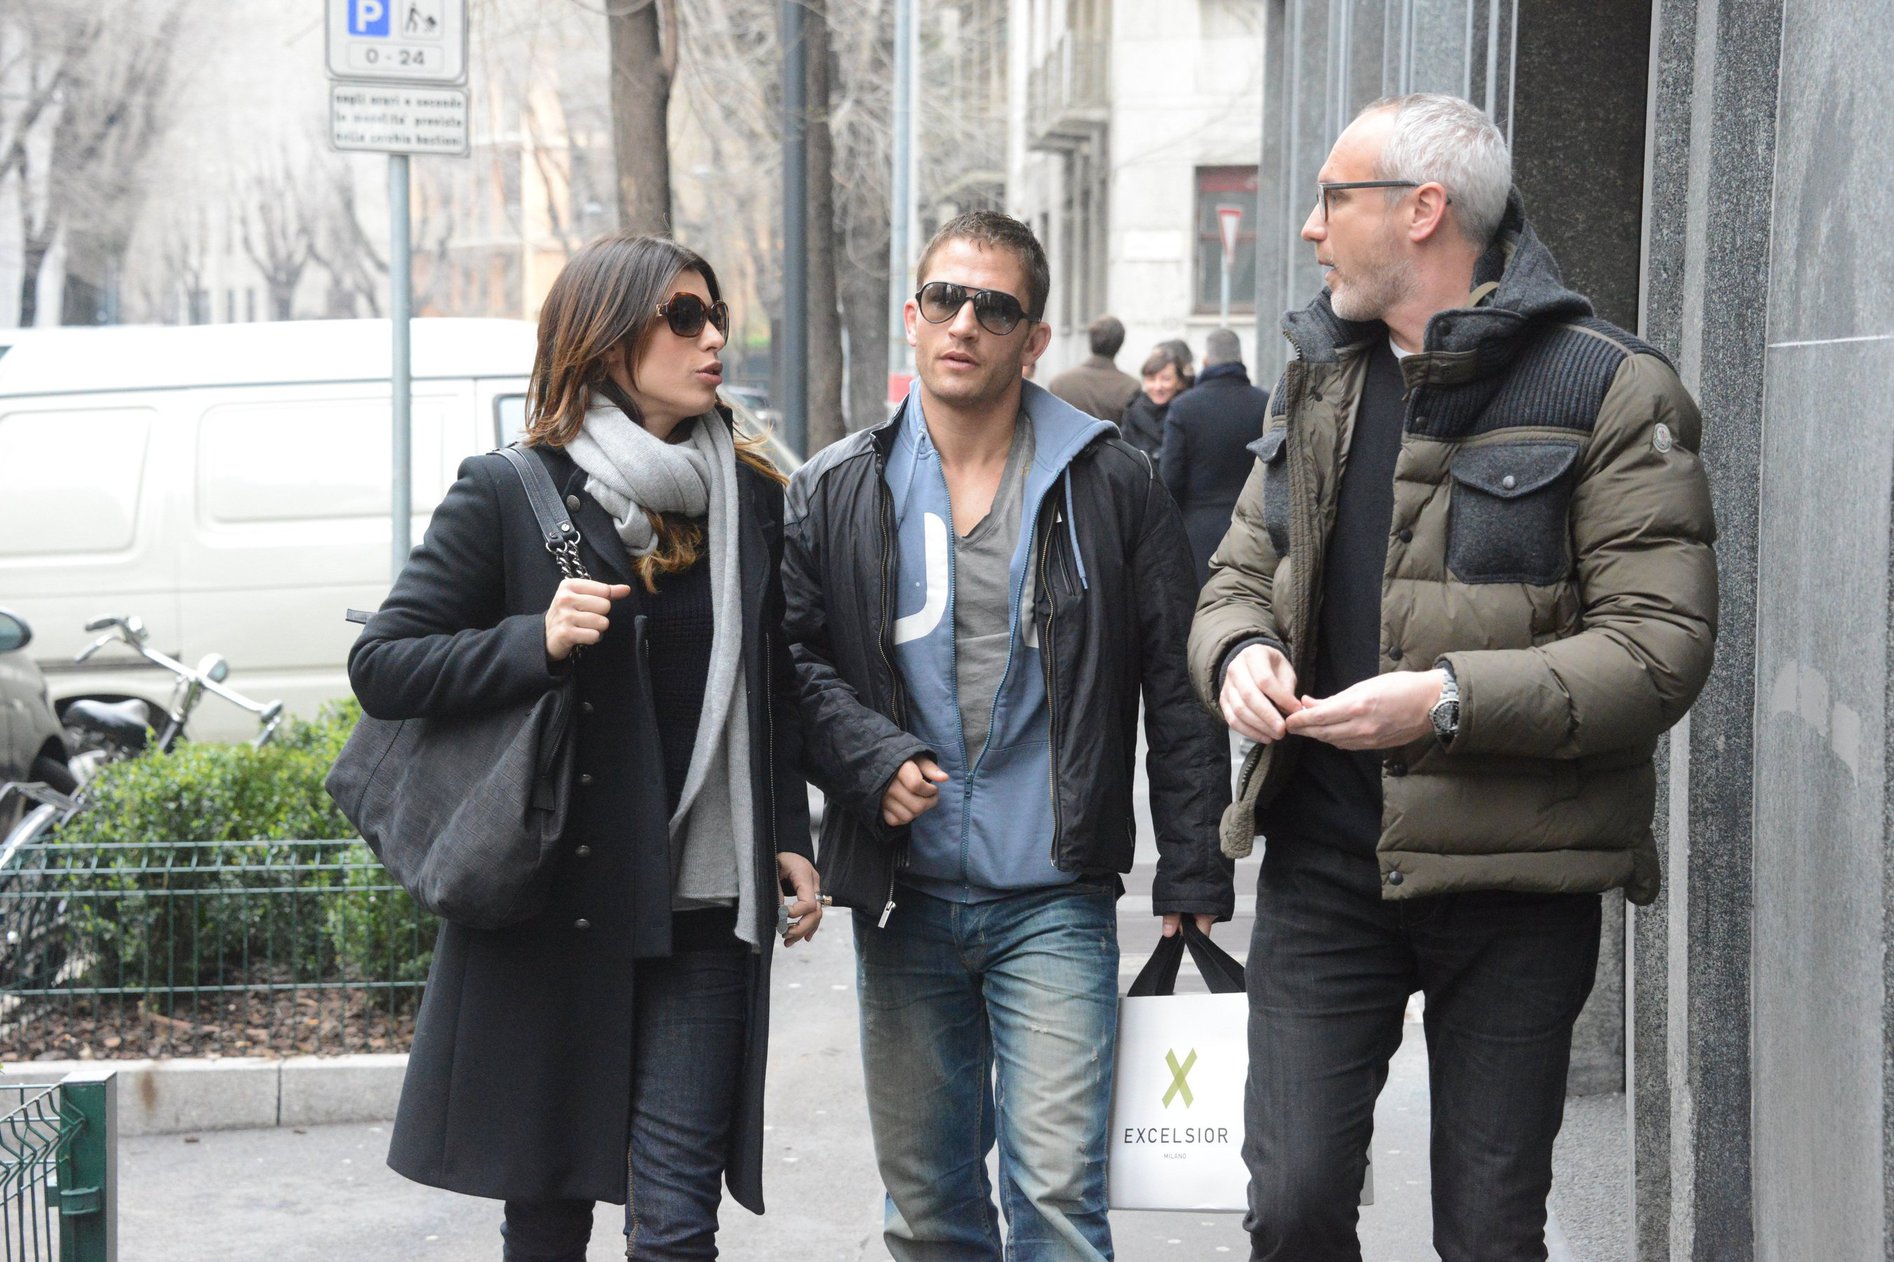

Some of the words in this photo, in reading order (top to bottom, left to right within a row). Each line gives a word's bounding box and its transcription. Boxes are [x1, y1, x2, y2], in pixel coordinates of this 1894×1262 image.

[356, 0, 384, 33] P
[365, 47, 380, 64] 0
[399, 49, 425, 66] 24
[1124, 1127, 1229, 1144] EXCELSIOR
[1163, 1152, 1187, 1160] MILANO
